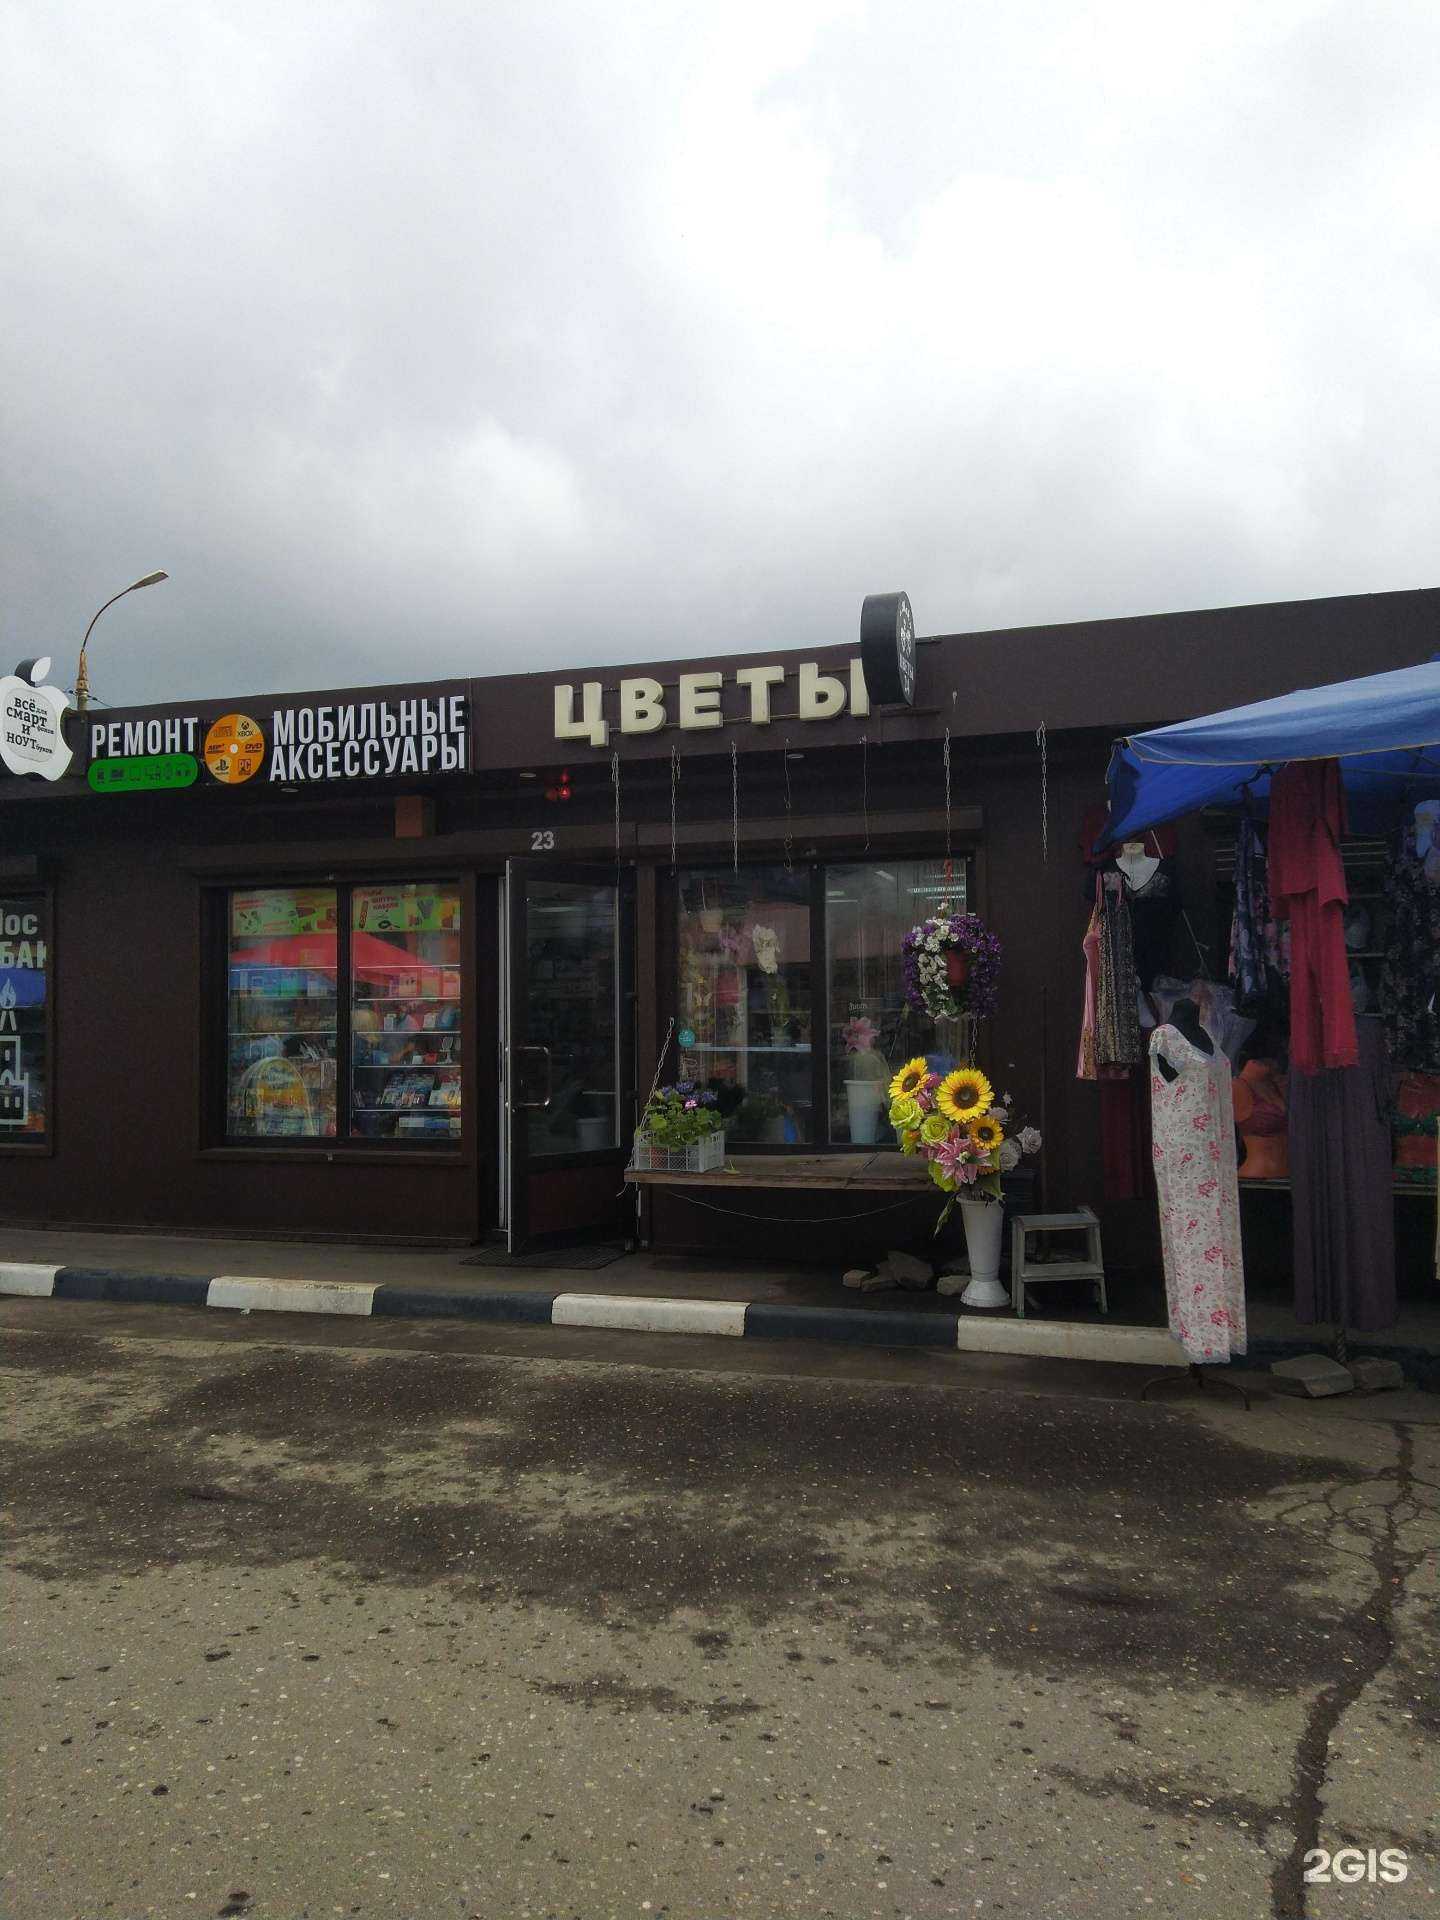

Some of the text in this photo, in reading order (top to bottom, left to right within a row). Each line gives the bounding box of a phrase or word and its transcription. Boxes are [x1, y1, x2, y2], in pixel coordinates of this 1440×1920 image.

[273, 696, 465, 746] МОБИЛЬНЫЕ
[554, 658, 870, 748] ЦВЕТЫ
[91, 717, 198, 758] РЕМОНТ
[269, 732, 465, 782] АКСЕССУАРЫ
[531, 831, 555, 850] 23
[0, 908, 39, 936] ос
